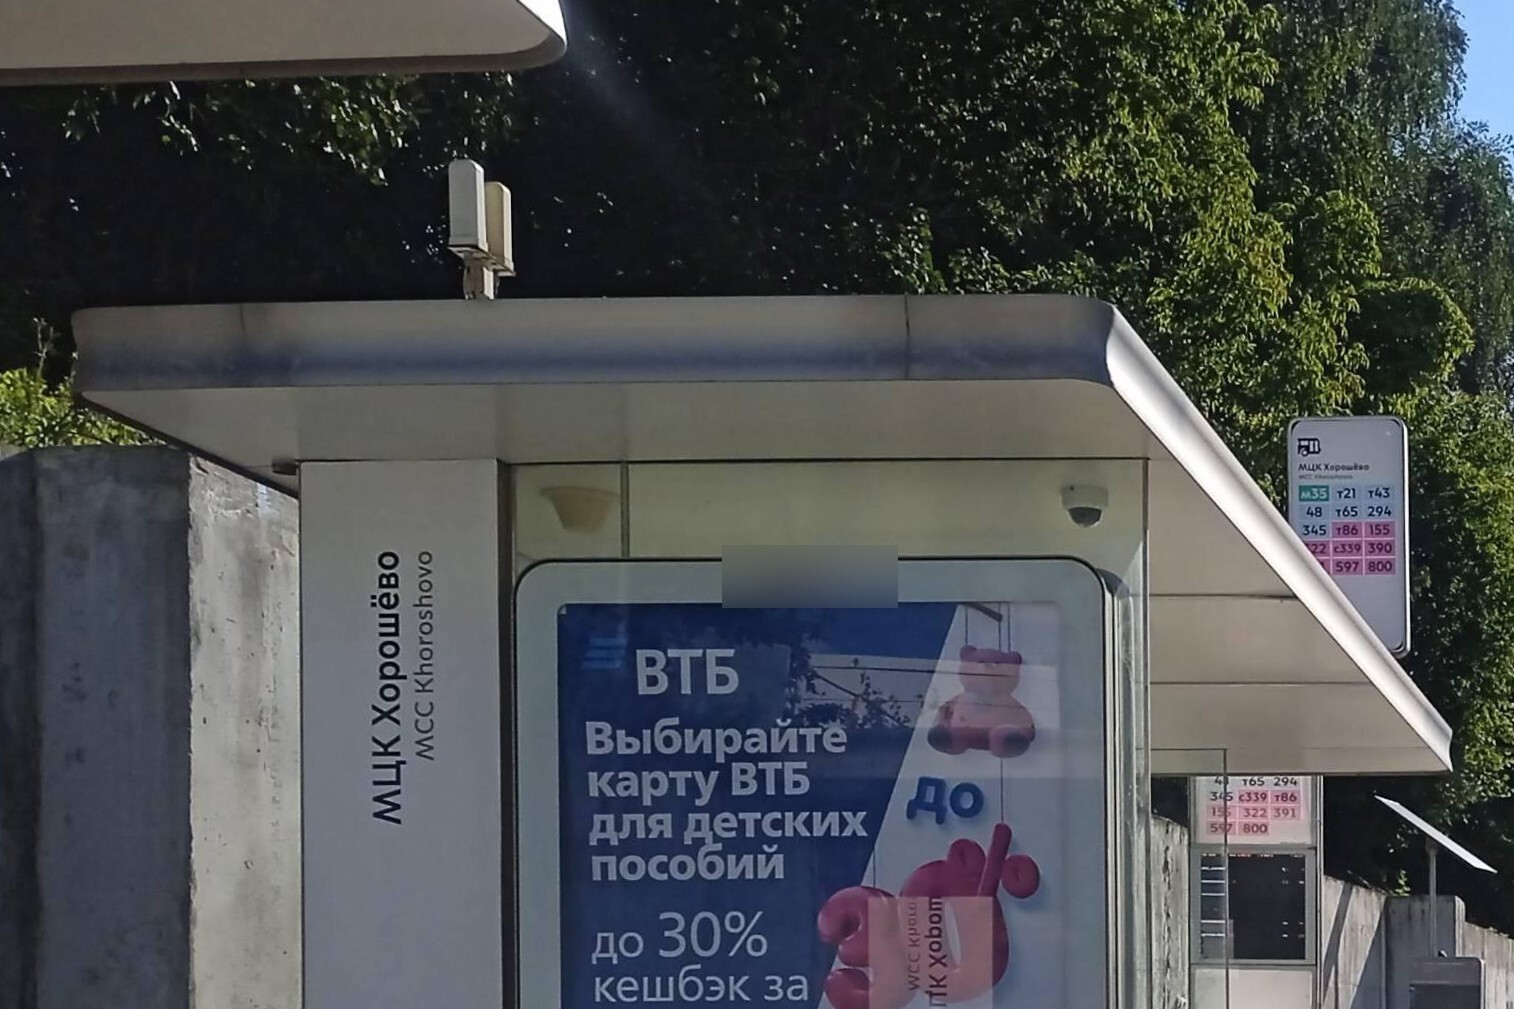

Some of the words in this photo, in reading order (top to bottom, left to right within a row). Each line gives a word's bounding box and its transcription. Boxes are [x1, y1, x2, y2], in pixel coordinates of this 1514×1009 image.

[1298, 463, 1322, 472] МЦК
[1300, 487, 1328, 500] м35
[1337, 488, 1356, 499] т21
[1368, 487, 1390, 499] т43
[1306, 506, 1323, 518] 48
[1335, 506, 1358, 518] т65
[1367, 506, 1392, 517] 294
[1302, 525, 1327, 536] 345
[1337, 525, 1358, 536] т86
[1369, 524, 1390, 535] 155
[1368, 542, 1392, 553] 390
[1336, 561, 1359, 572] 597
[1368, 561, 1392, 572] 800
[370, 551, 407, 725] Хорошёво
[413, 551, 434, 694] Khoroshovo
[634, 647, 739, 696] ВТБ
[414, 701, 434, 761] MCC
[585, 717, 847, 759] Выбирайте
[371, 734, 407, 825] МЦК
[588, 769, 719, 805] карту
[731, 761, 811, 796] ВТБ
[1241, 776, 1265, 786] т65
[1273, 776, 1298, 786] 294
[1274, 792, 1297, 802] т86
[906, 776, 984, 825] до
[1243, 808, 1267, 817] 322
[1273, 808, 1296, 817] 391
[589, 812, 672, 845] для
[684, 809, 867, 844] детских
[1243, 823, 1268, 833] 800
[591, 842, 785, 882] пособий
[591, 930, 643, 965] до
[658, 911, 768, 958] 30%
[595, 965, 750, 1003] кешбэк
[764, 973, 808, 1001] за
